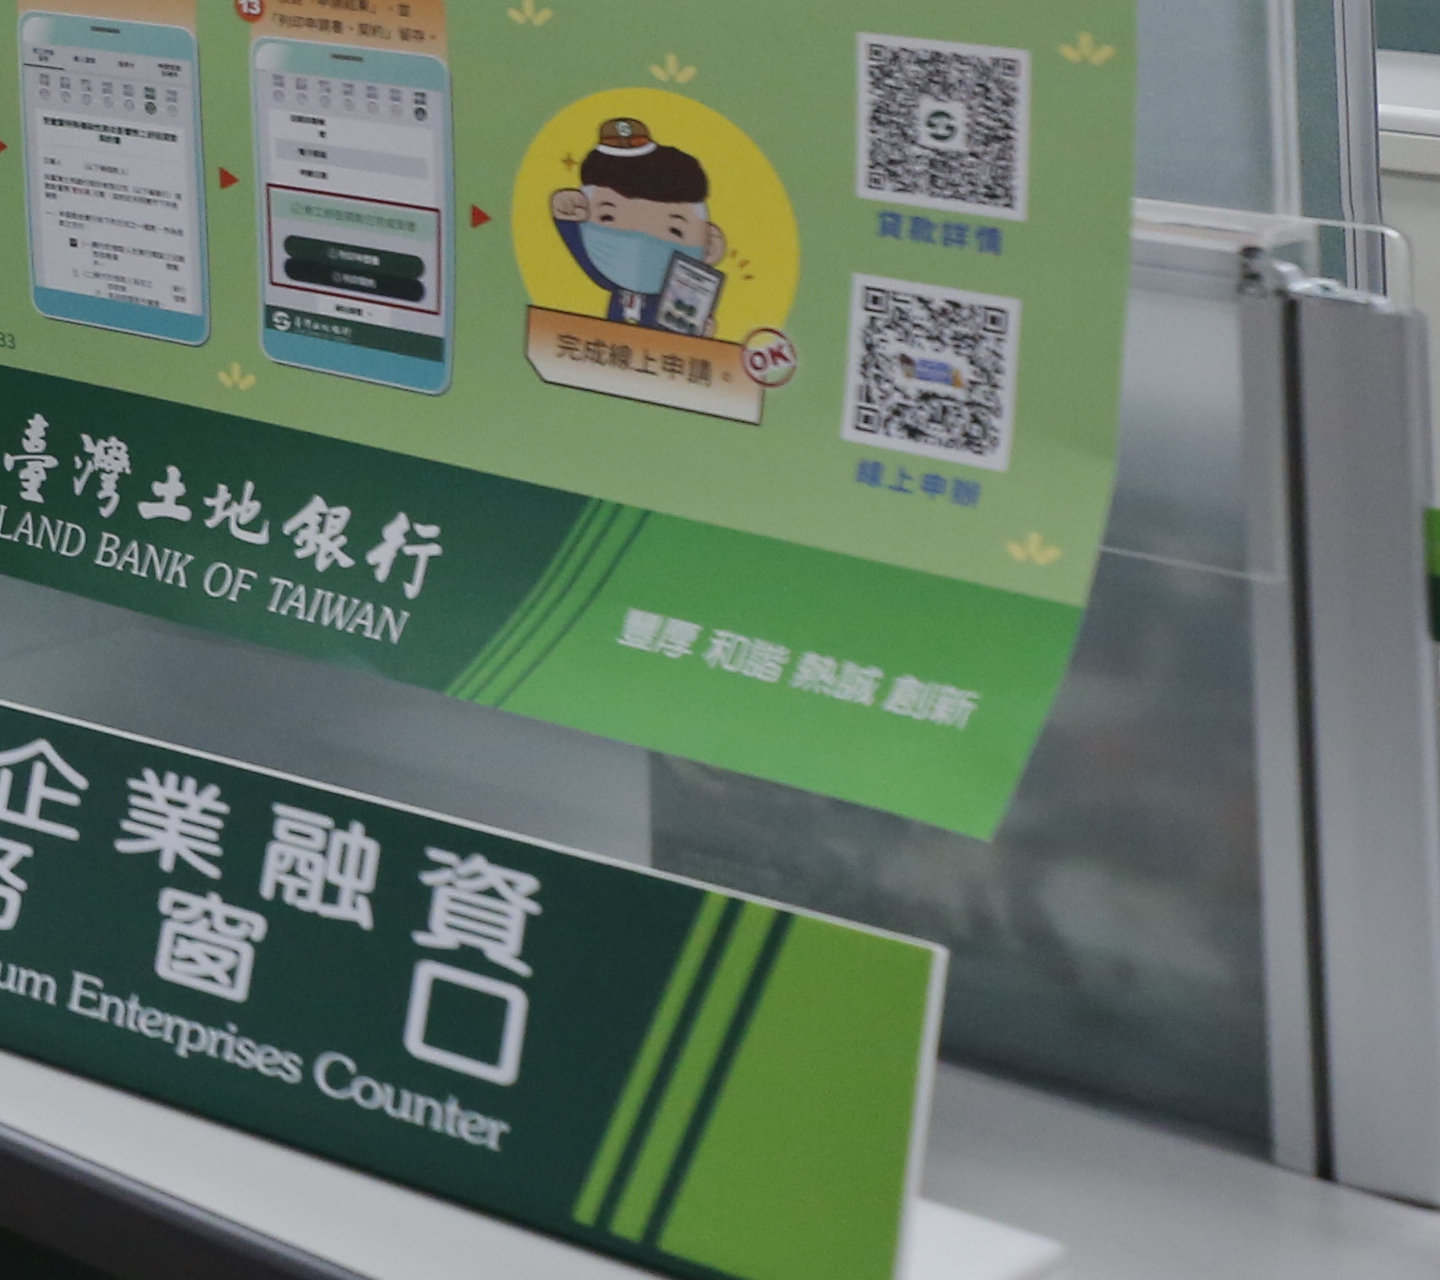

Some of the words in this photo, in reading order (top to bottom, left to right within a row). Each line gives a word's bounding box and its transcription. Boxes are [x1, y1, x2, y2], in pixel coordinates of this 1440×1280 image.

[748, 344, 791, 374] OK
[3, 413, 444, 599] 臺灣土地銀行
[96, 529, 189, 590] BANK
[202, 557, 253, 601] OF
[266, 575, 412, 645] TAIWAN
[883, 671, 978, 732] 創新
[69, 972, 304, 1085] Enterprises
[315, 1048, 509, 1153] Counter
